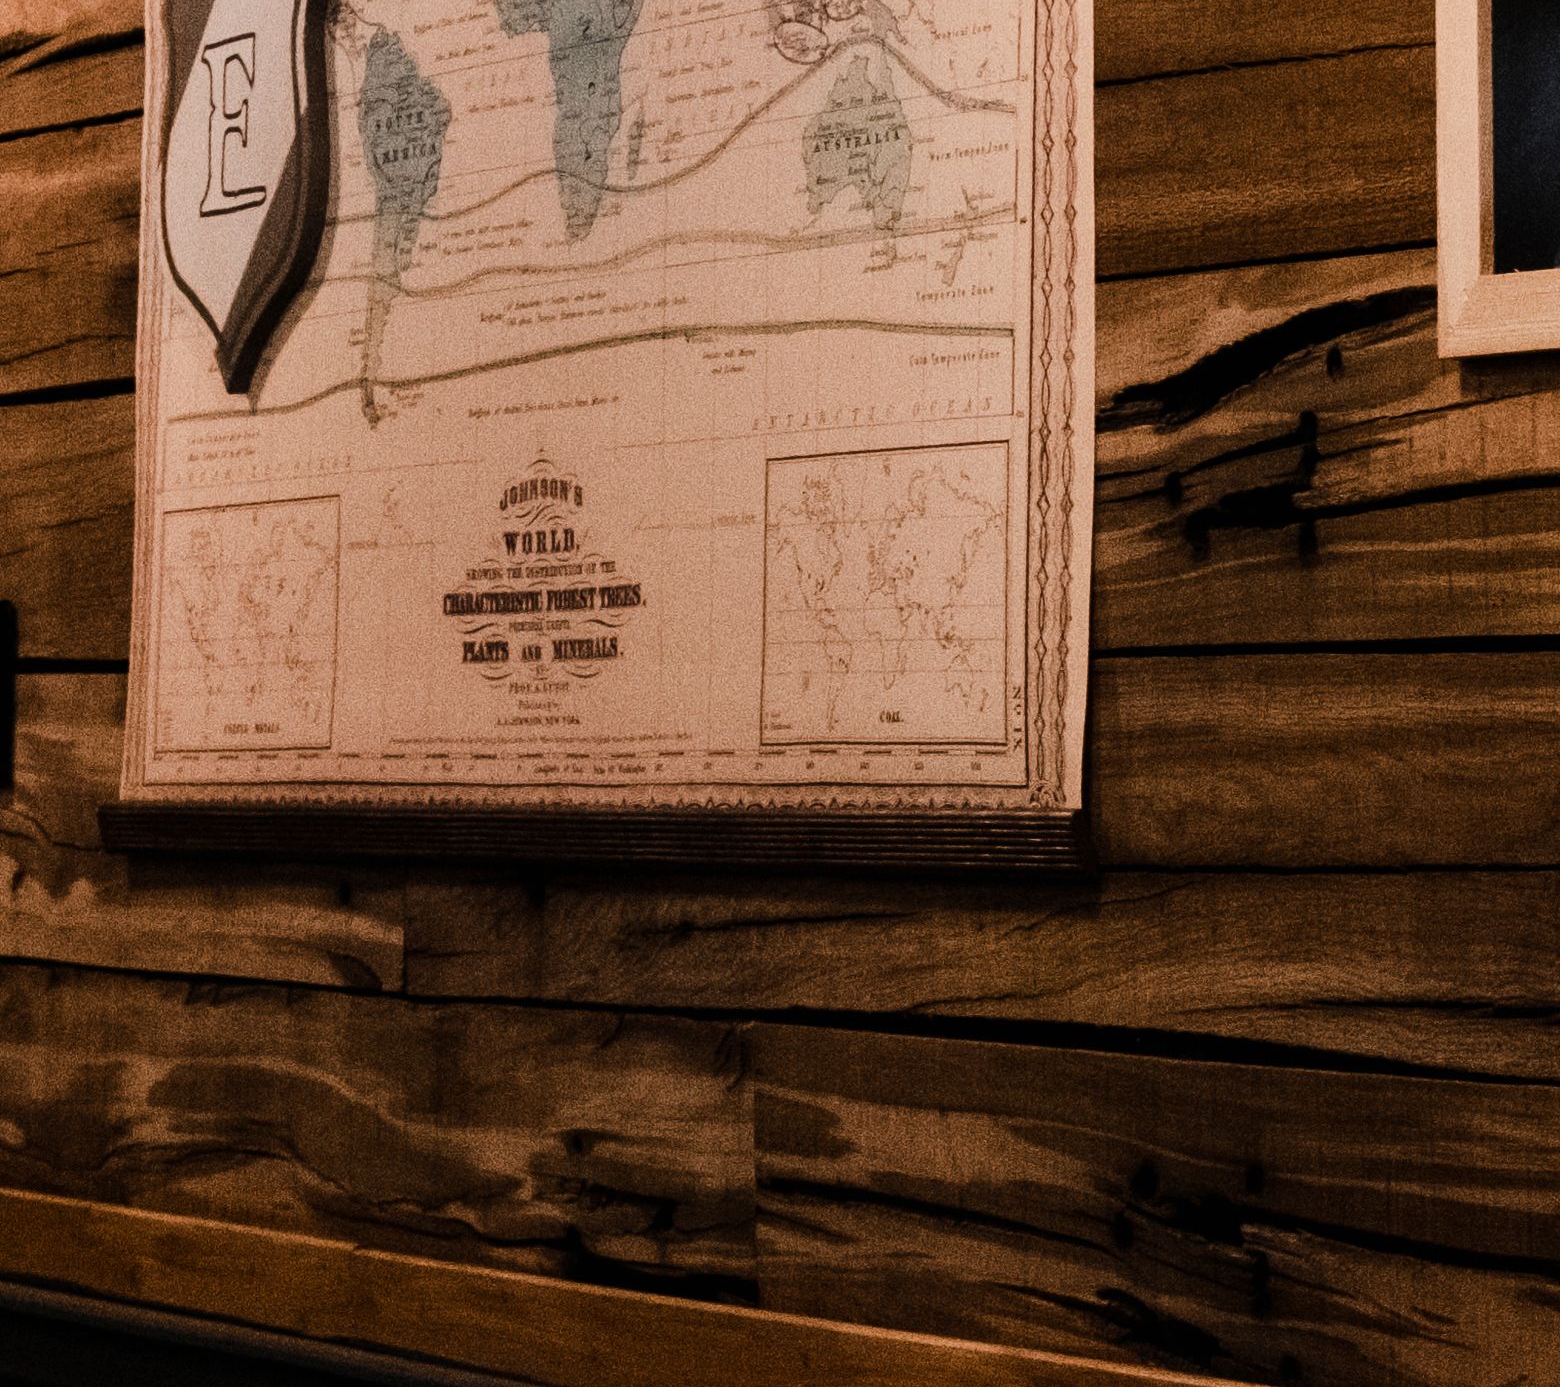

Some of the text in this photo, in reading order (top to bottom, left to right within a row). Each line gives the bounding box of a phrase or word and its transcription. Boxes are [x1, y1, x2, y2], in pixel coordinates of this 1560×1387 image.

[200, 32, 267, 217] E
[814, 129, 901, 154] AUSTRALIA
[499, 478, 584, 512] JOHNSON'S
[442, 590, 543, 616] CHARACTERISTIC
[545, 587, 597, 612] FOREST
[461, 639, 510, 664] PLANTS
[520, 644, 542, 663] AND
